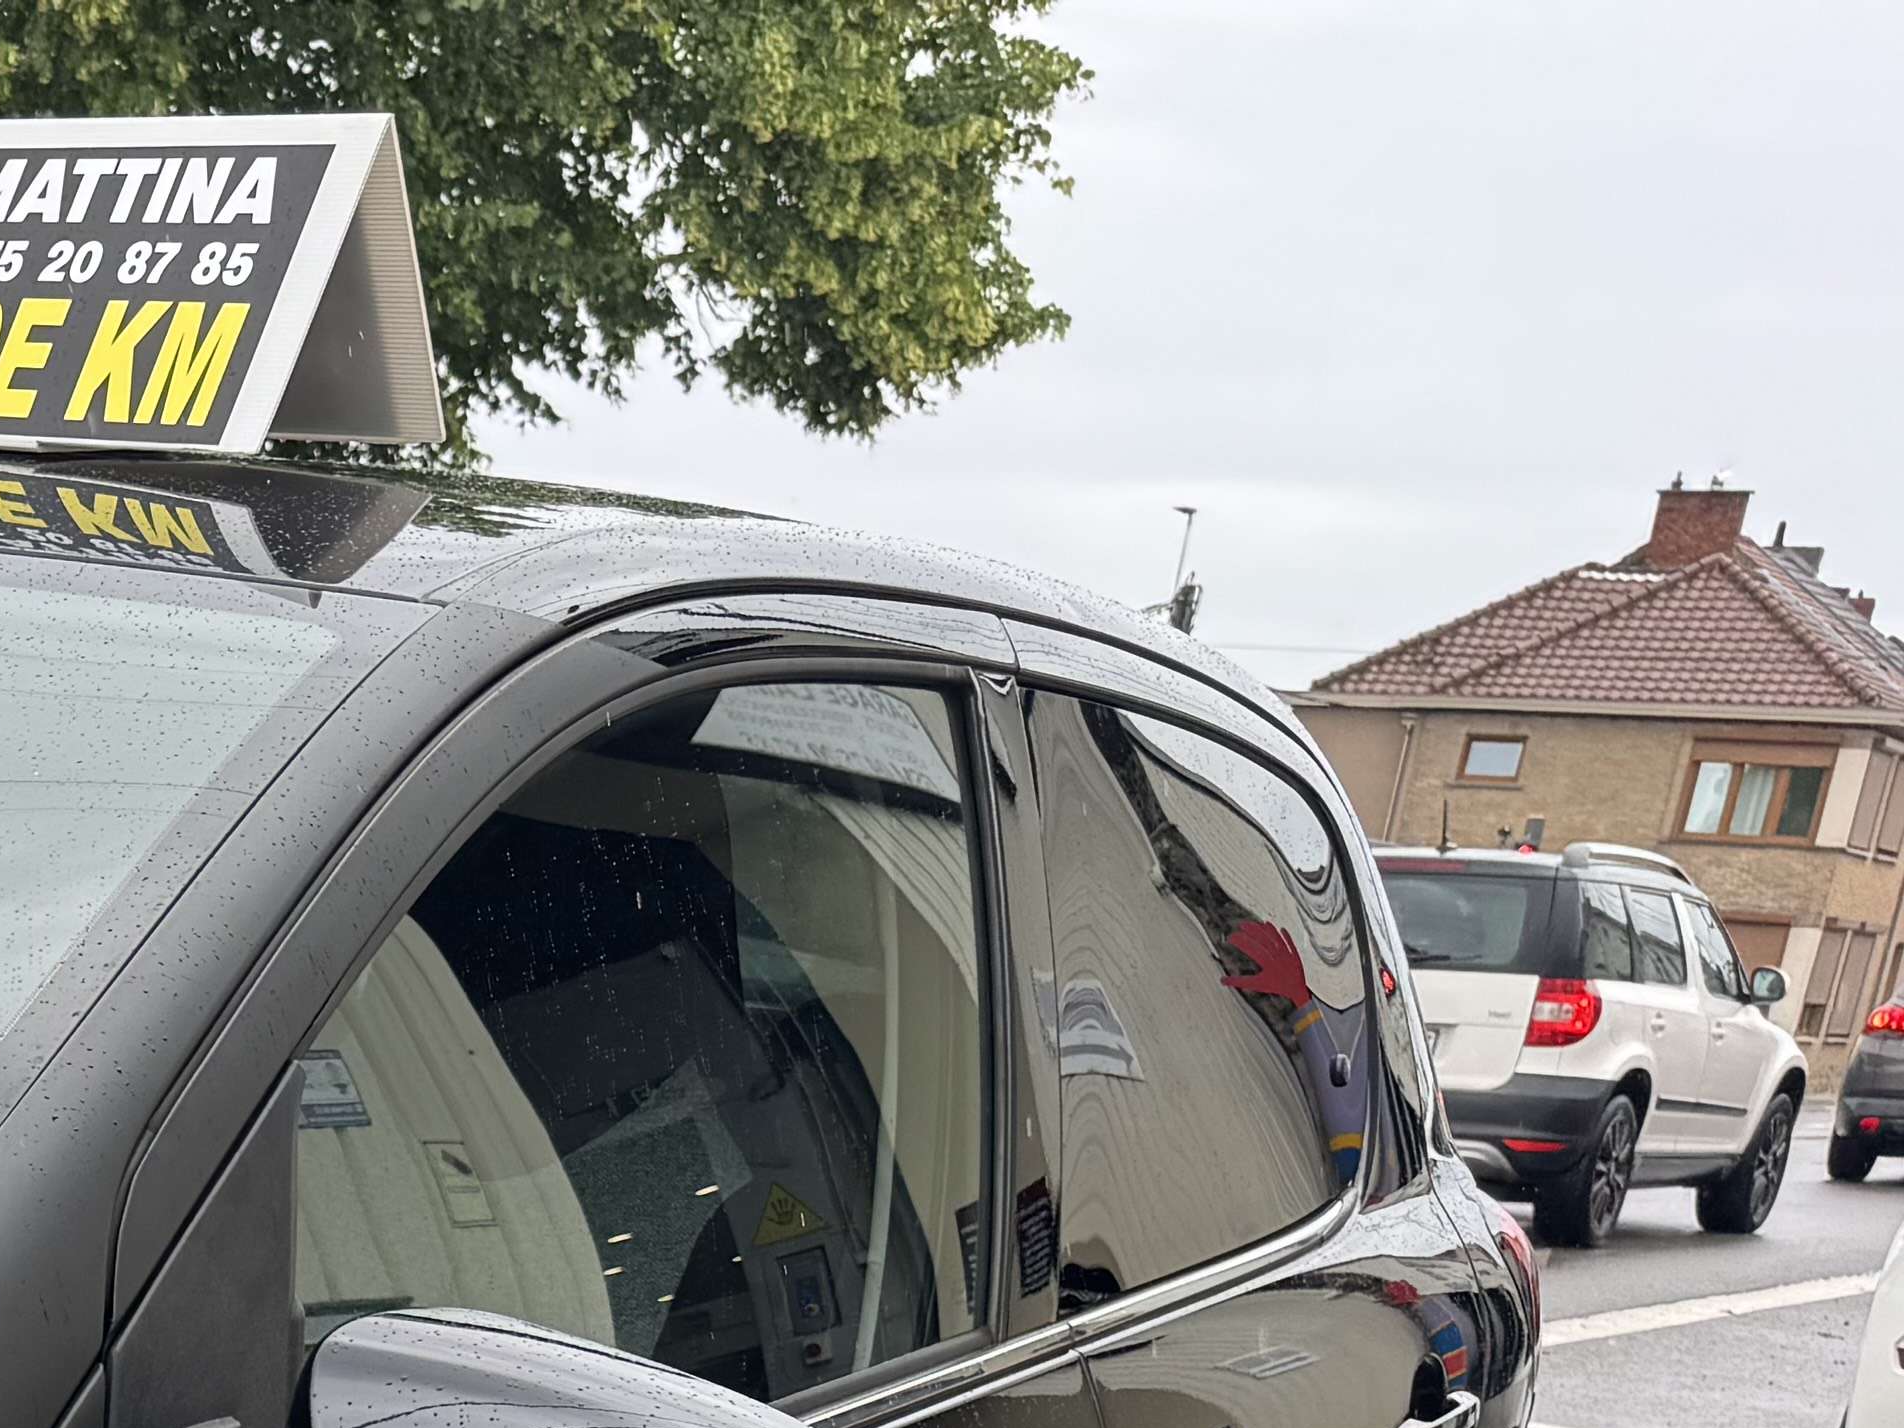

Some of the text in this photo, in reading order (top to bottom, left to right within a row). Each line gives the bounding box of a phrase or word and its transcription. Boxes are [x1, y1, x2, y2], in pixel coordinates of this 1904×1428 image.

[37, 239, 104, 284] 20
[117, 240, 183, 284] 87
[190, 241, 260, 287] 85
[64, 300, 251, 426] KM
